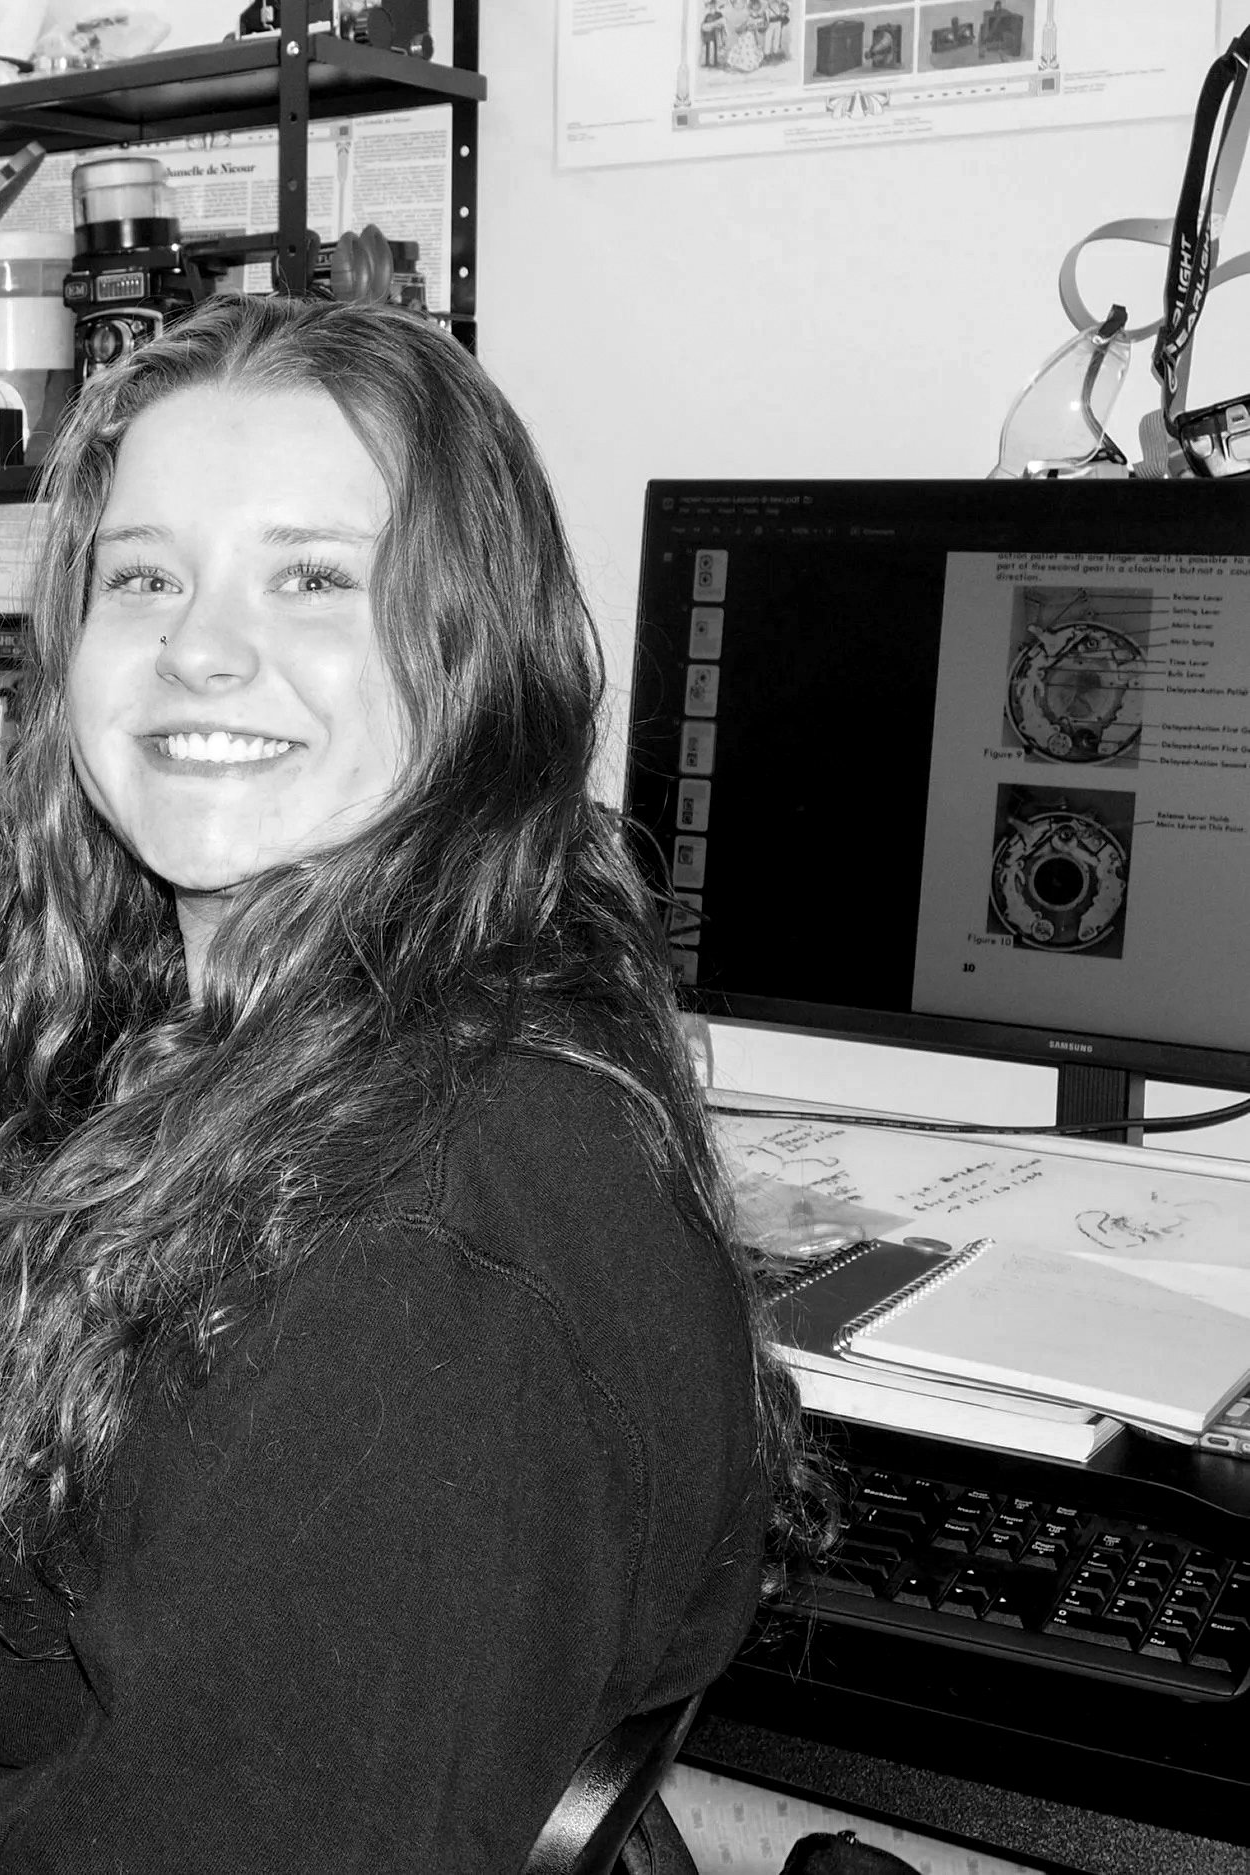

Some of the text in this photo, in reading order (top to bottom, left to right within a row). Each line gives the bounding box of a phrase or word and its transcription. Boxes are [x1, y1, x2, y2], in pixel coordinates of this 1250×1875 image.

[206, 164, 220, 175] de
[1189, 555, 1228, 565] possible
[997, 562, 1015, 571] part
[1032, 562, 1046, 570] the
[1048, 563, 1080, 571] second
[1083, 565, 1103, 574] gear
[1106, 564, 1115, 572] in
[1128, 563, 1176, 573] clockwise
[1179, 566, 1195, 574] but
[983, 748, 1023, 760] Figure 9
[967, 934, 1012, 946] Figure 10
[963, 963, 976, 972] 10
[1049, 1040, 1093, 1053] SAMSUNG
[863, 1488, 907, 1501] Backspace
[957, 1506, 980, 1514] Insert
[1000, 1514, 1023, 1522] Home
[944, 1523, 970, 1532] Delete
[1046, 1523, 1066, 1531] Page
[1031, 1545, 1055, 1553] Down
[1035, 1541, 1055, 1549] Page
[1211, 1623, 1235, 1631] Enter
